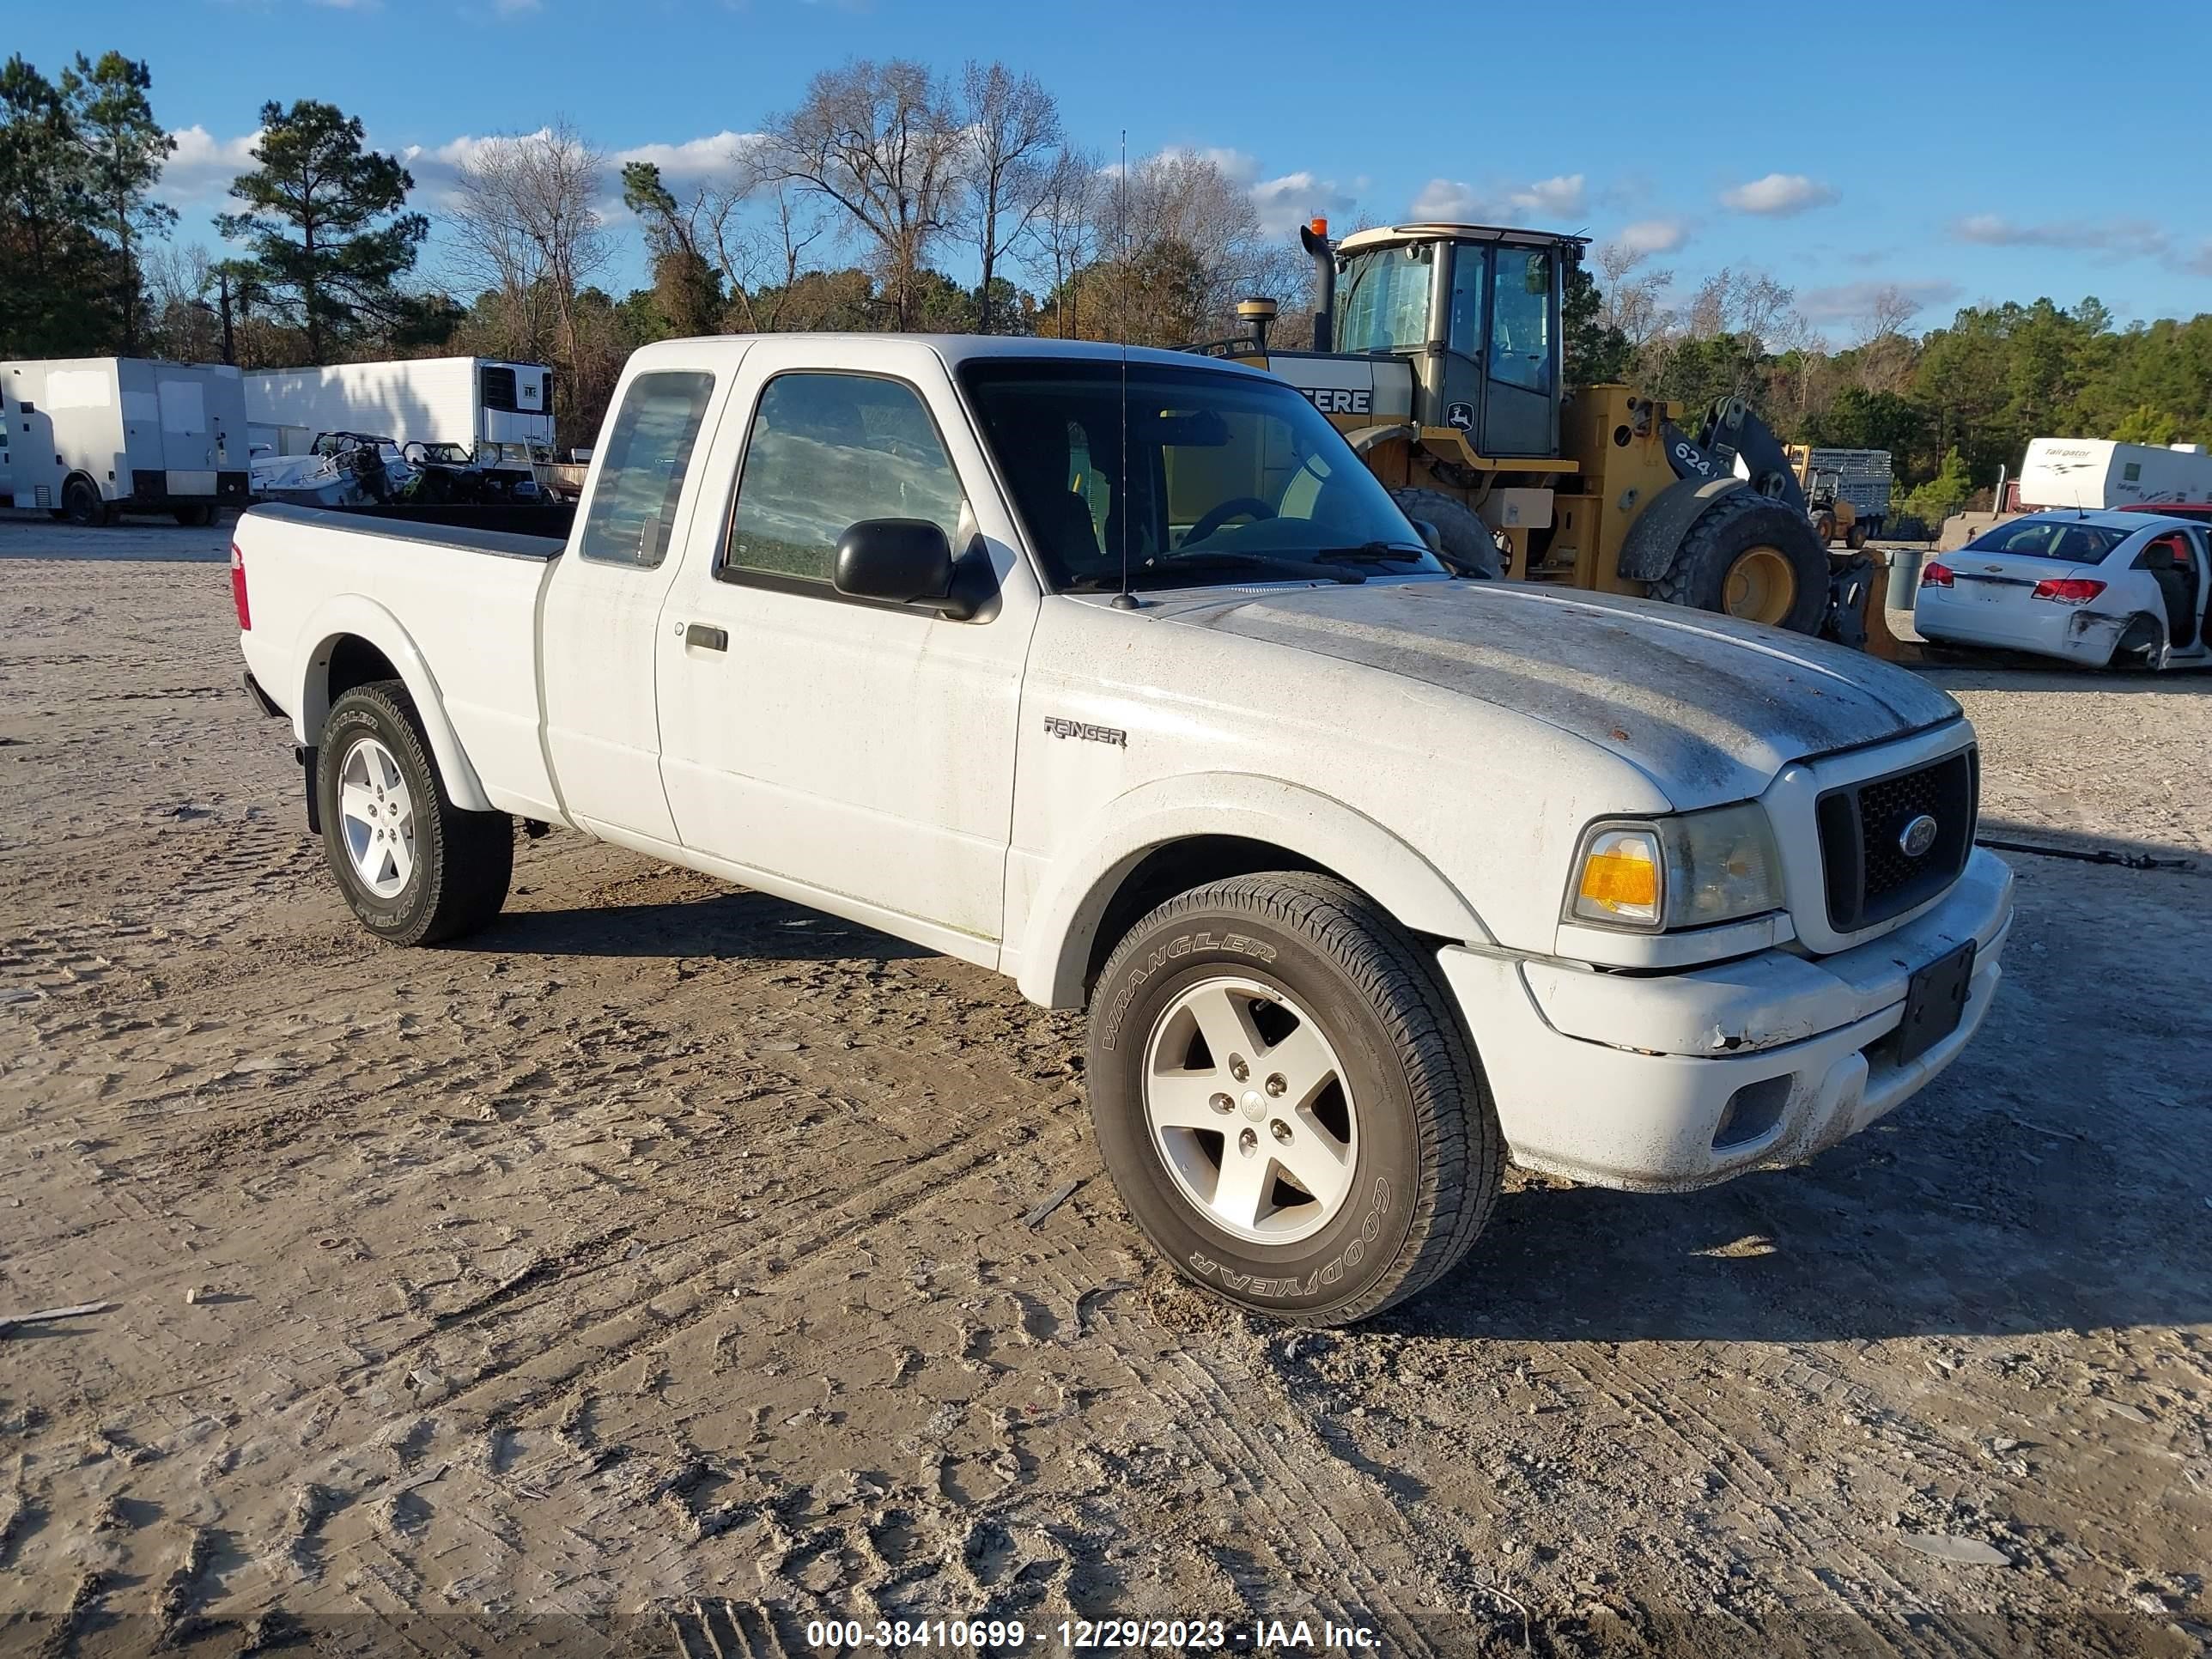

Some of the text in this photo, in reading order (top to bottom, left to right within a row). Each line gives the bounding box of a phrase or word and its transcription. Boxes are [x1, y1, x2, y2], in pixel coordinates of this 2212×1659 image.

[1301, 389, 1370, 413] ERE
[1675, 442, 1718, 477] 624
[1043, 715, 1127, 747] RANGER
[1102, 932, 1278, 1051] WRANGLER
[1188, 1176, 1392, 1298] GOODYEAR
